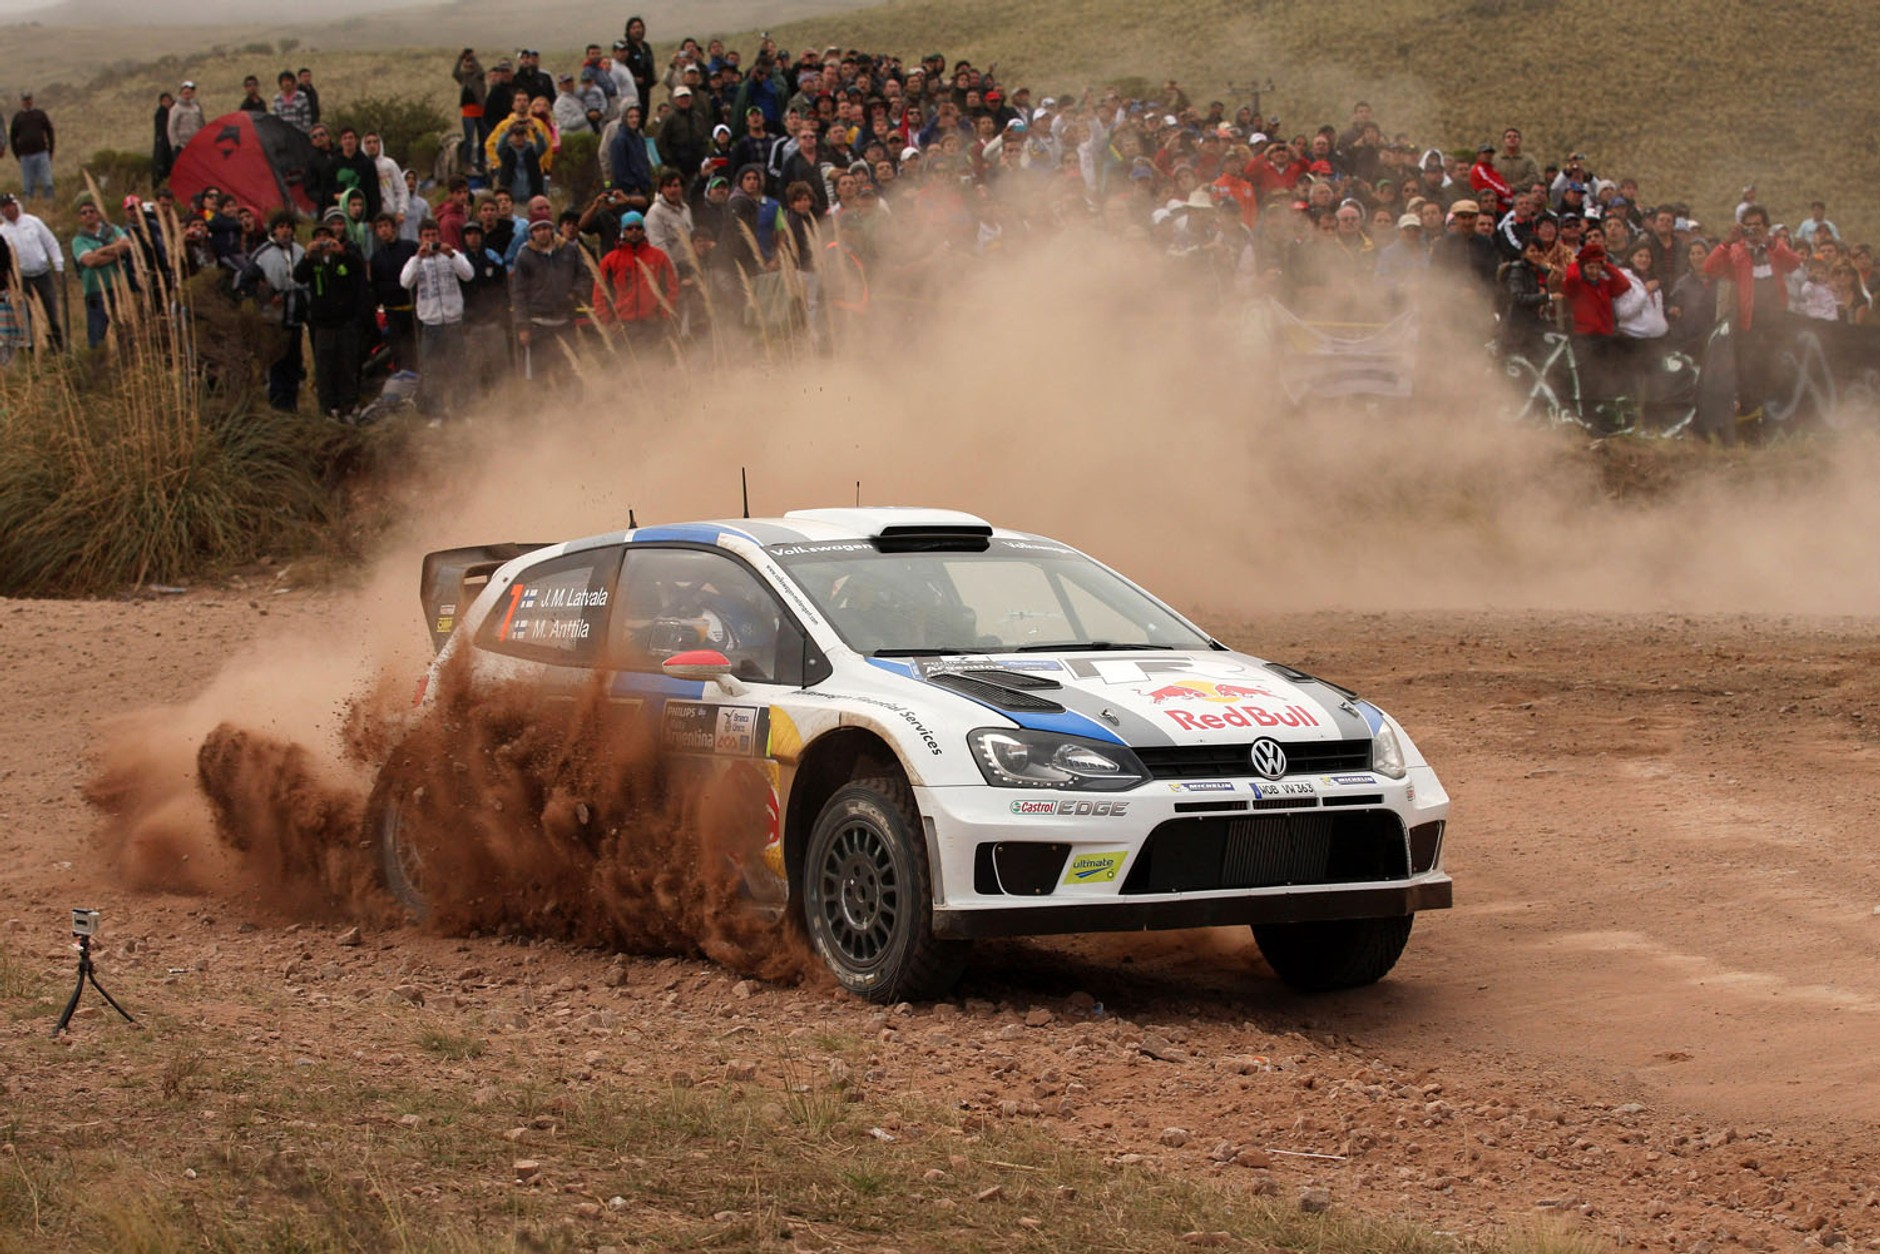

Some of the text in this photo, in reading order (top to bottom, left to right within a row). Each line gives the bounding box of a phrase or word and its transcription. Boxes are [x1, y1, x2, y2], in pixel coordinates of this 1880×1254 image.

[770, 543, 873, 556] Volkswagen
[567, 587, 608, 606] Latvala
[500, 583, 524, 643] 1
[532, 619, 589, 639] M. Anttila
[667, 706, 696, 718] PHILIPS
[900, 706, 943, 756] Services
[1259, 785, 1279, 794] WOB
[1021, 800, 1130, 816] Castrol EDGE
[1073, 858, 1114, 869] ultimate
